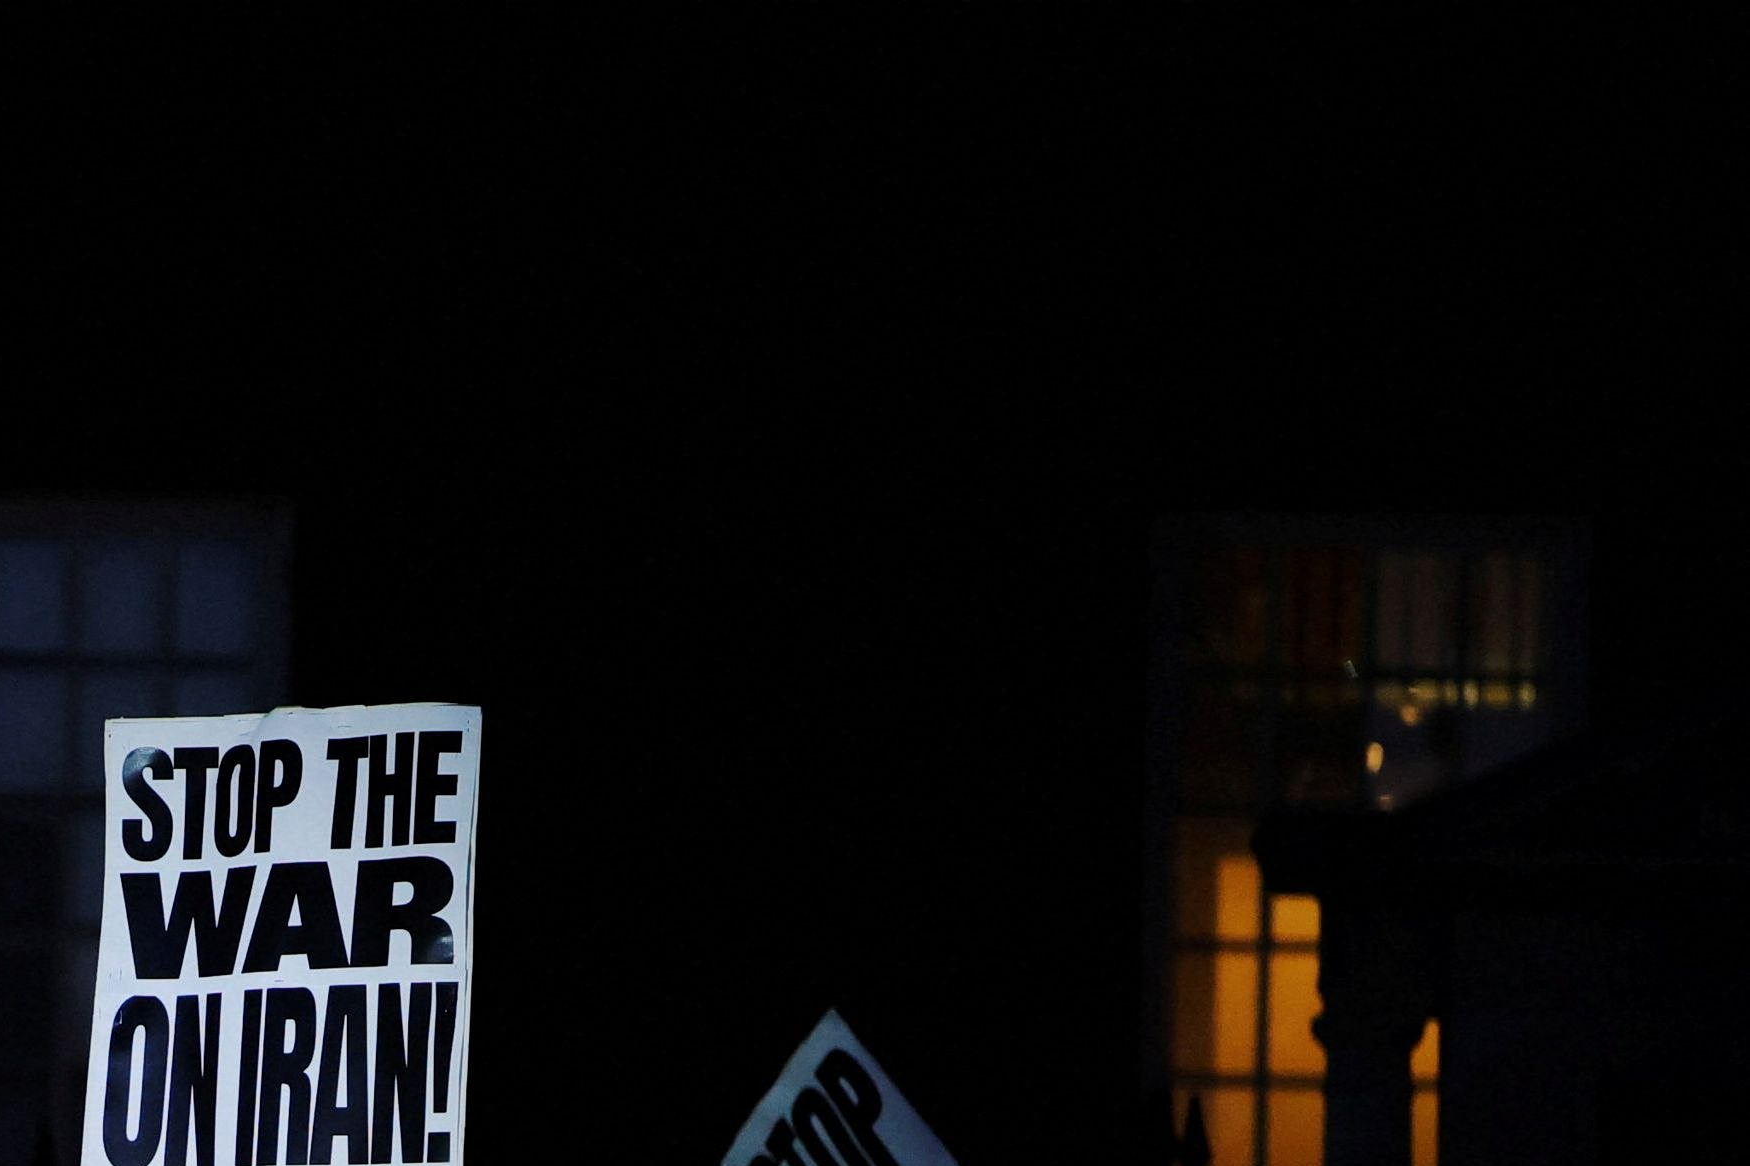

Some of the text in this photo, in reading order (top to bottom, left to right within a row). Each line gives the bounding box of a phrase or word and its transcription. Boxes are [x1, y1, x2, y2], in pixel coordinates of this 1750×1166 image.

[121, 731, 463, 861] STOP THE
[120, 856, 454, 979] WAR
